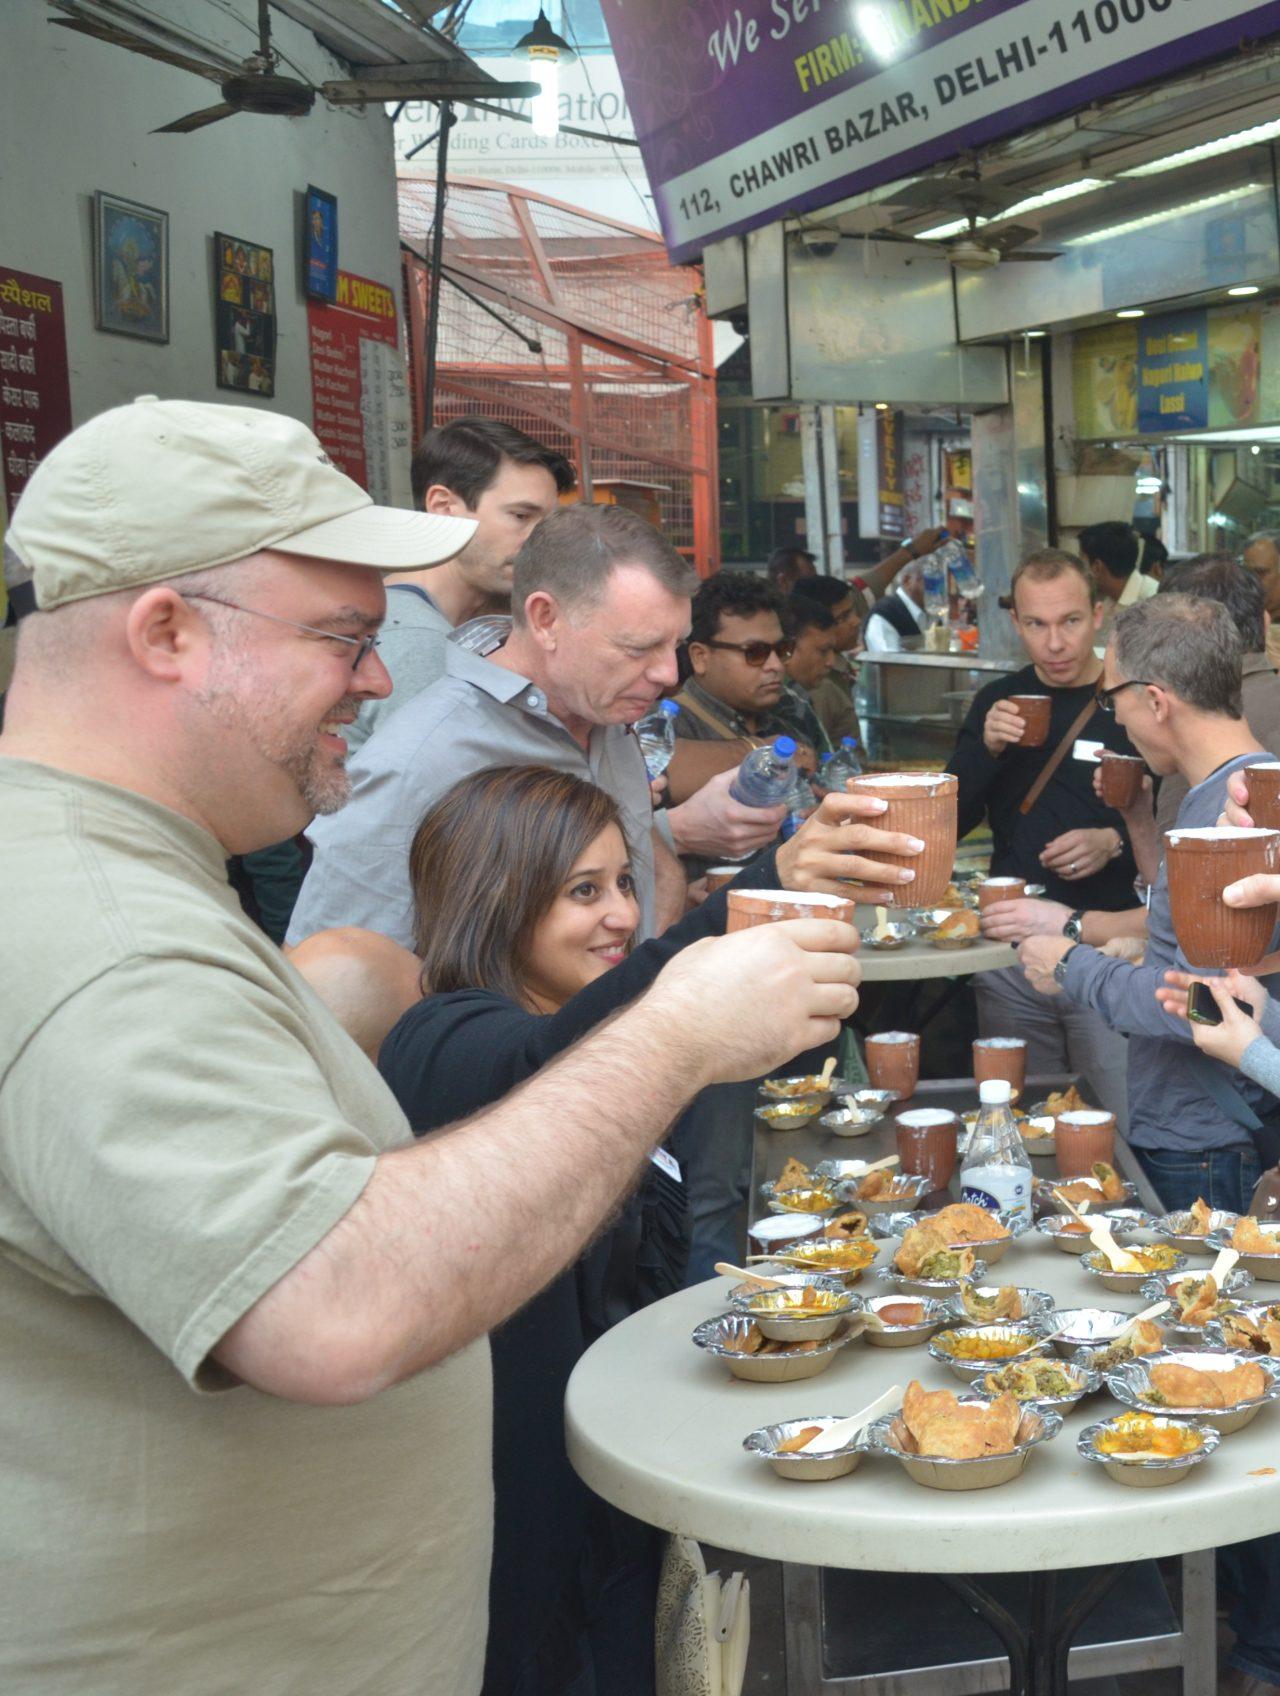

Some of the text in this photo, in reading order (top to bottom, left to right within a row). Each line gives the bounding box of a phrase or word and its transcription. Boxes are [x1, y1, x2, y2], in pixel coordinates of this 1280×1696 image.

[708, 9, 760, 72] We
[794, 32, 864, 93] FIRM:
[496, 132, 548, 151] Cards
[679, 187, 721, 220] 112,
[729, 136, 821, 199] CHAWRI
[824, 91, 930, 155] BAZAR,
[351, 279, 395, 319] SWEETS
